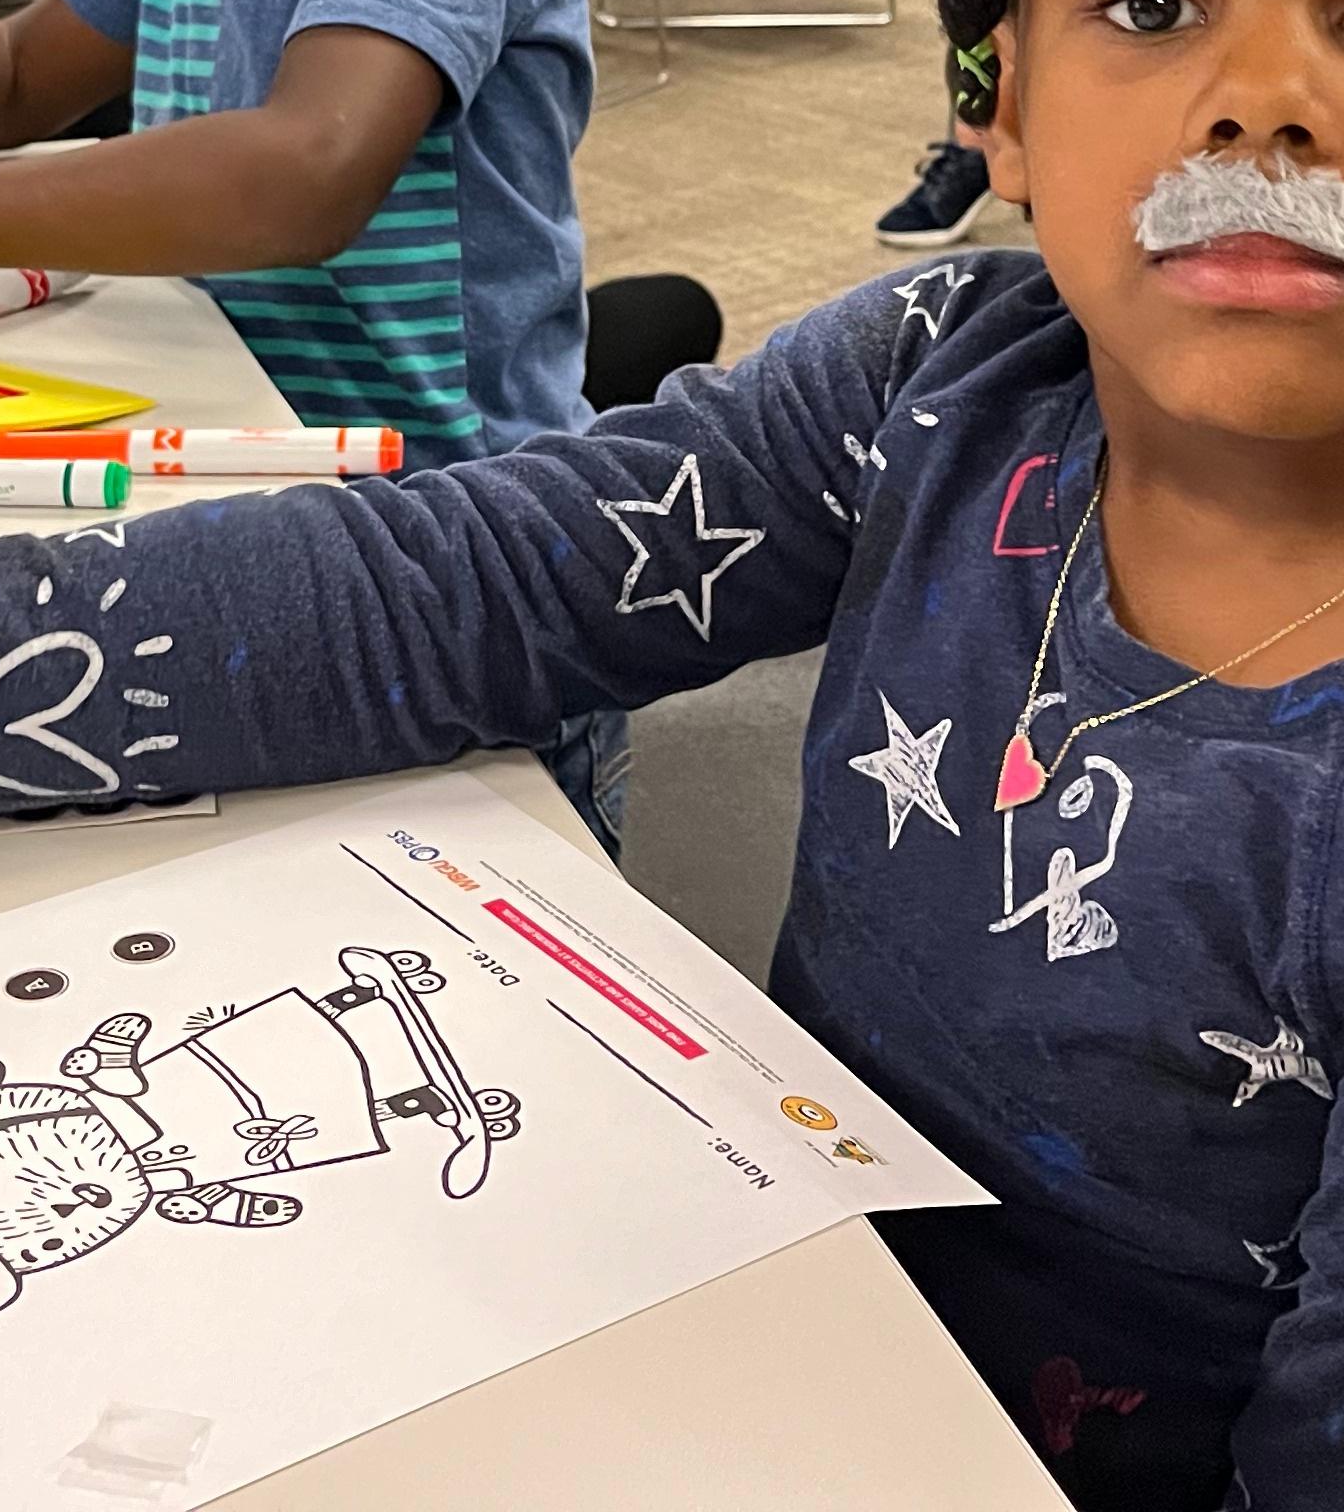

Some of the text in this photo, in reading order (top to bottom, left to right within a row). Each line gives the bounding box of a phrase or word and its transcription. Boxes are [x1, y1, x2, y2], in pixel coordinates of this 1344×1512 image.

[130, 941, 154, 954] B
[467, 949, 520, 986] Date:
[25, 977, 50, 993] A
[707, 1138, 775, 1190] Name:
